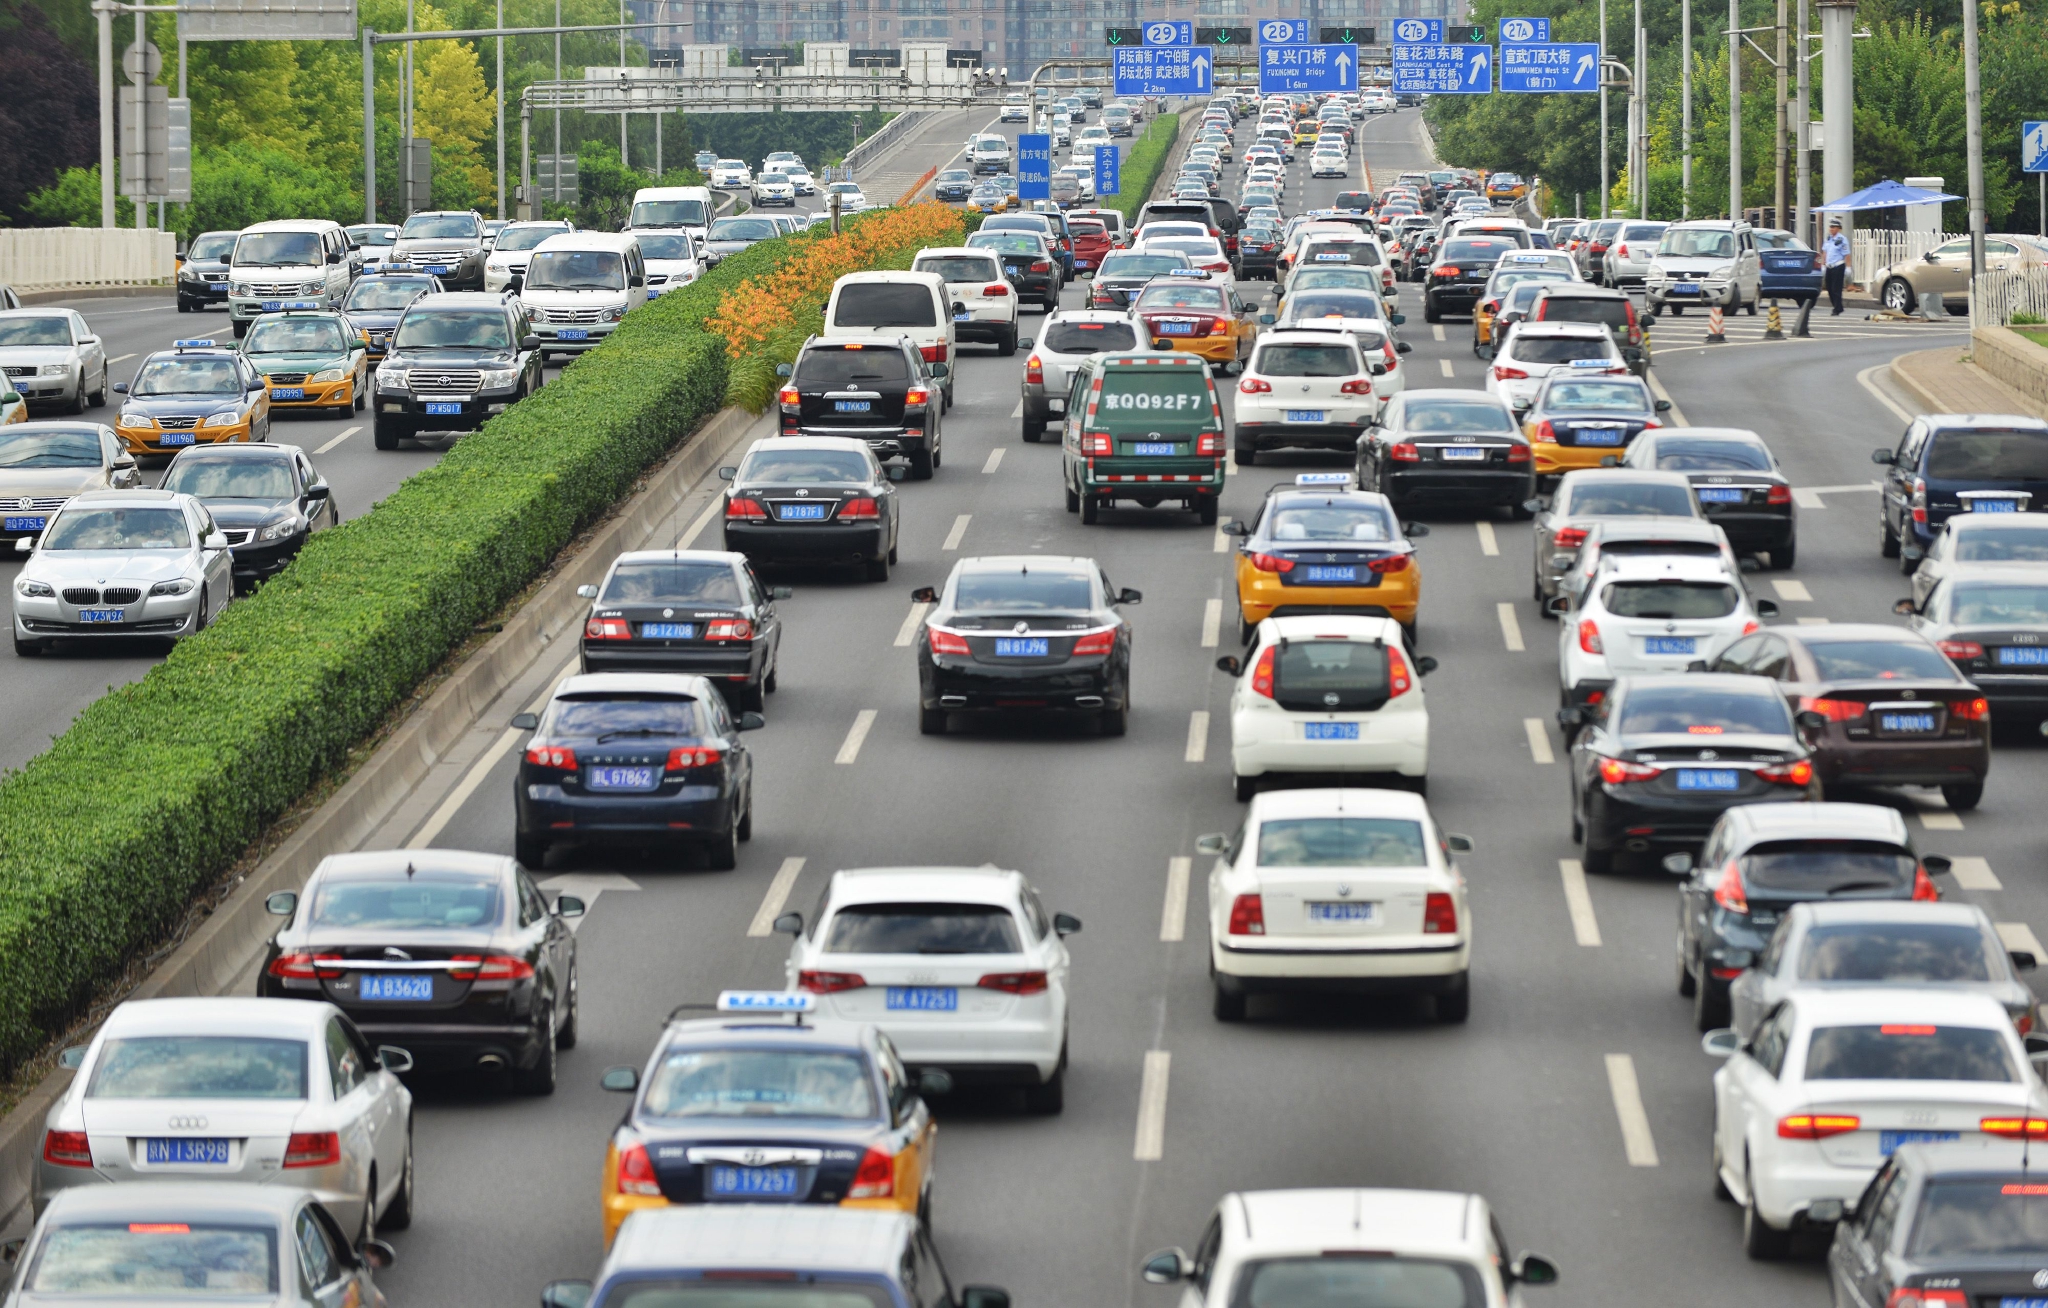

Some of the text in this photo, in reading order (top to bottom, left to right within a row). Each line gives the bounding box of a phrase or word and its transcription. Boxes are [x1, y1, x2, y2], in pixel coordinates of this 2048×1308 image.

[1152, 27, 1171, 41] 29
[1181, 24, 1189, 43] 出口
[1268, 25, 1287, 39] 28
[1297, 21, 1304, 41] 出口
[1403, 23, 1422, 38] 27B
[1431, 21, 1438, 41] 出口
[1508, 23, 1528, 37] 27A
[1538, 20, 1545, 40] 出口
[1118, 49, 1189, 64] 月坛南街 广宁伯街
[1266, 48, 1327, 65] 复兴门桥
[1396, 46, 1464, 60] 莲花池东路
[1505, 48, 1571, 64] 宣武门西大街
[1118, 66, 1152, 80] 月坛北街
[1306, 68, 1325, 77] Bridge
[1399, 68, 1457, 79] 西三环 莲花桥
[1020, 149, 1048, 160] 前方弯道
[1102, 148, 1113, 192] 天宁寺桥
[1105, 393, 1201, 410] 京QQ92F7
